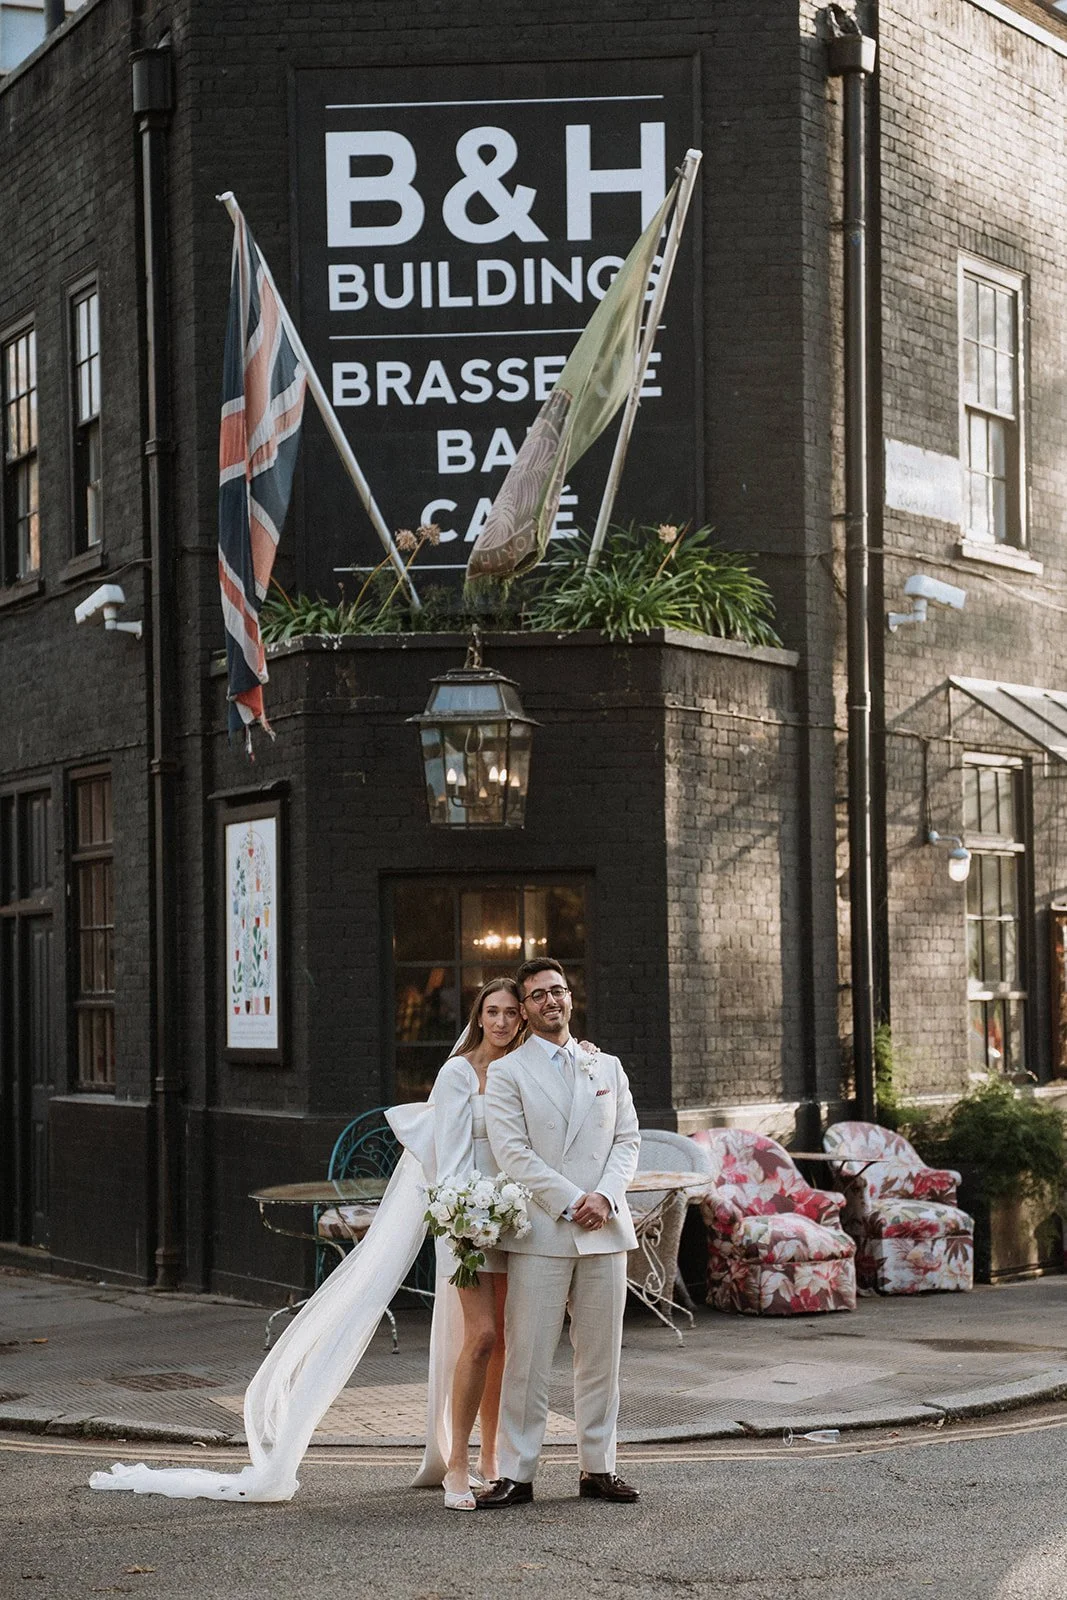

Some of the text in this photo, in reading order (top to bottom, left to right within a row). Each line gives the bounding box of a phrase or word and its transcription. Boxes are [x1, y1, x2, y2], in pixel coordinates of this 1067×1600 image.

[325, 122, 667, 247] B&H
[332, 352, 662, 407] BRASSEE
[437, 427, 533, 475] BA
[420, 484, 579, 544] CAÉ
